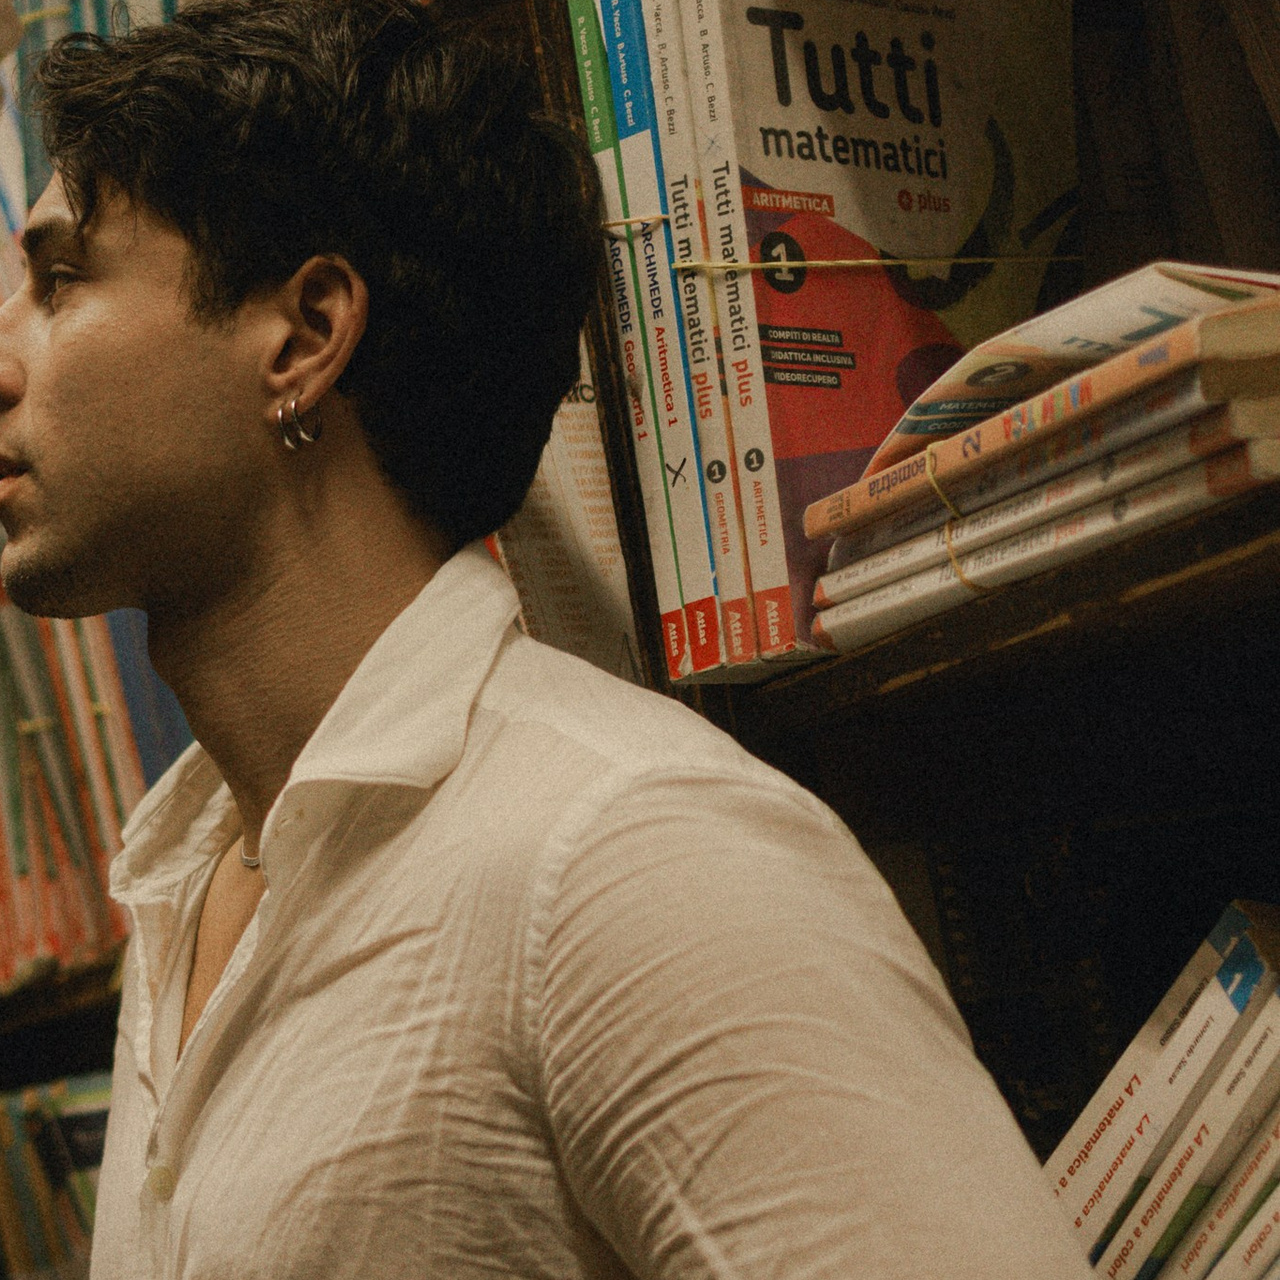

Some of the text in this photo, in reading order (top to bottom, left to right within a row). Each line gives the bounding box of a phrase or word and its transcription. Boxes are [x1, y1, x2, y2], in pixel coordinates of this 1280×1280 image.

[746, 7, 942, 128] Tutti
[667, 109, 676, 135] Bezzi
[706, 95, 718, 123] Bezzi
[760, 125, 948, 179] matematici
[752, 191, 952, 213] ARITMETICA plus
[771, 243, 795, 282] 1
[768, 329, 800, 341] COMPITI
[802, 332, 810, 341] DI
[771, 350, 854, 366] DIDATTICA INCLUSIVA
[774, 372, 838, 385] VIDEORECUPERO
[670, 174, 693, 229] Tutti
[692, 372, 714, 419] plus
[715, 491, 730, 555] GEOMETRIA
[728, 611, 743, 657] Atlas
[713, 161, 736, 217] Tutti
[732, 359, 753, 407] plus
[753, 481, 768, 547] ARITMETICA
[765, 599, 780, 647] Atlas
[608, 236, 633, 335] ARCHIMEDE
[668, 622, 680, 657] Atlas
[640, 221, 664, 321] ARCHIMEDE
[654, 325, 674, 415] Aritmetica
[696, 610, 708, 646] Atlas
[1123, 1074, 1143, 1097] LA
[1067, 1097, 1127, 1177] matematica
[1134, 1113, 1154, 1136] LA
[1191, 1123, 1213, 1147] LA
[1077, 1134, 1141, 1218] matematica
[1137, 1146, 1201, 1228] matematica
[1213, 1138, 1276, 1221] matematica
[1105, 1238, 1139, 1280] colori
[1178, 1232, 1212, 1274] colori
[1242, 1224, 1275, 1266] colori
